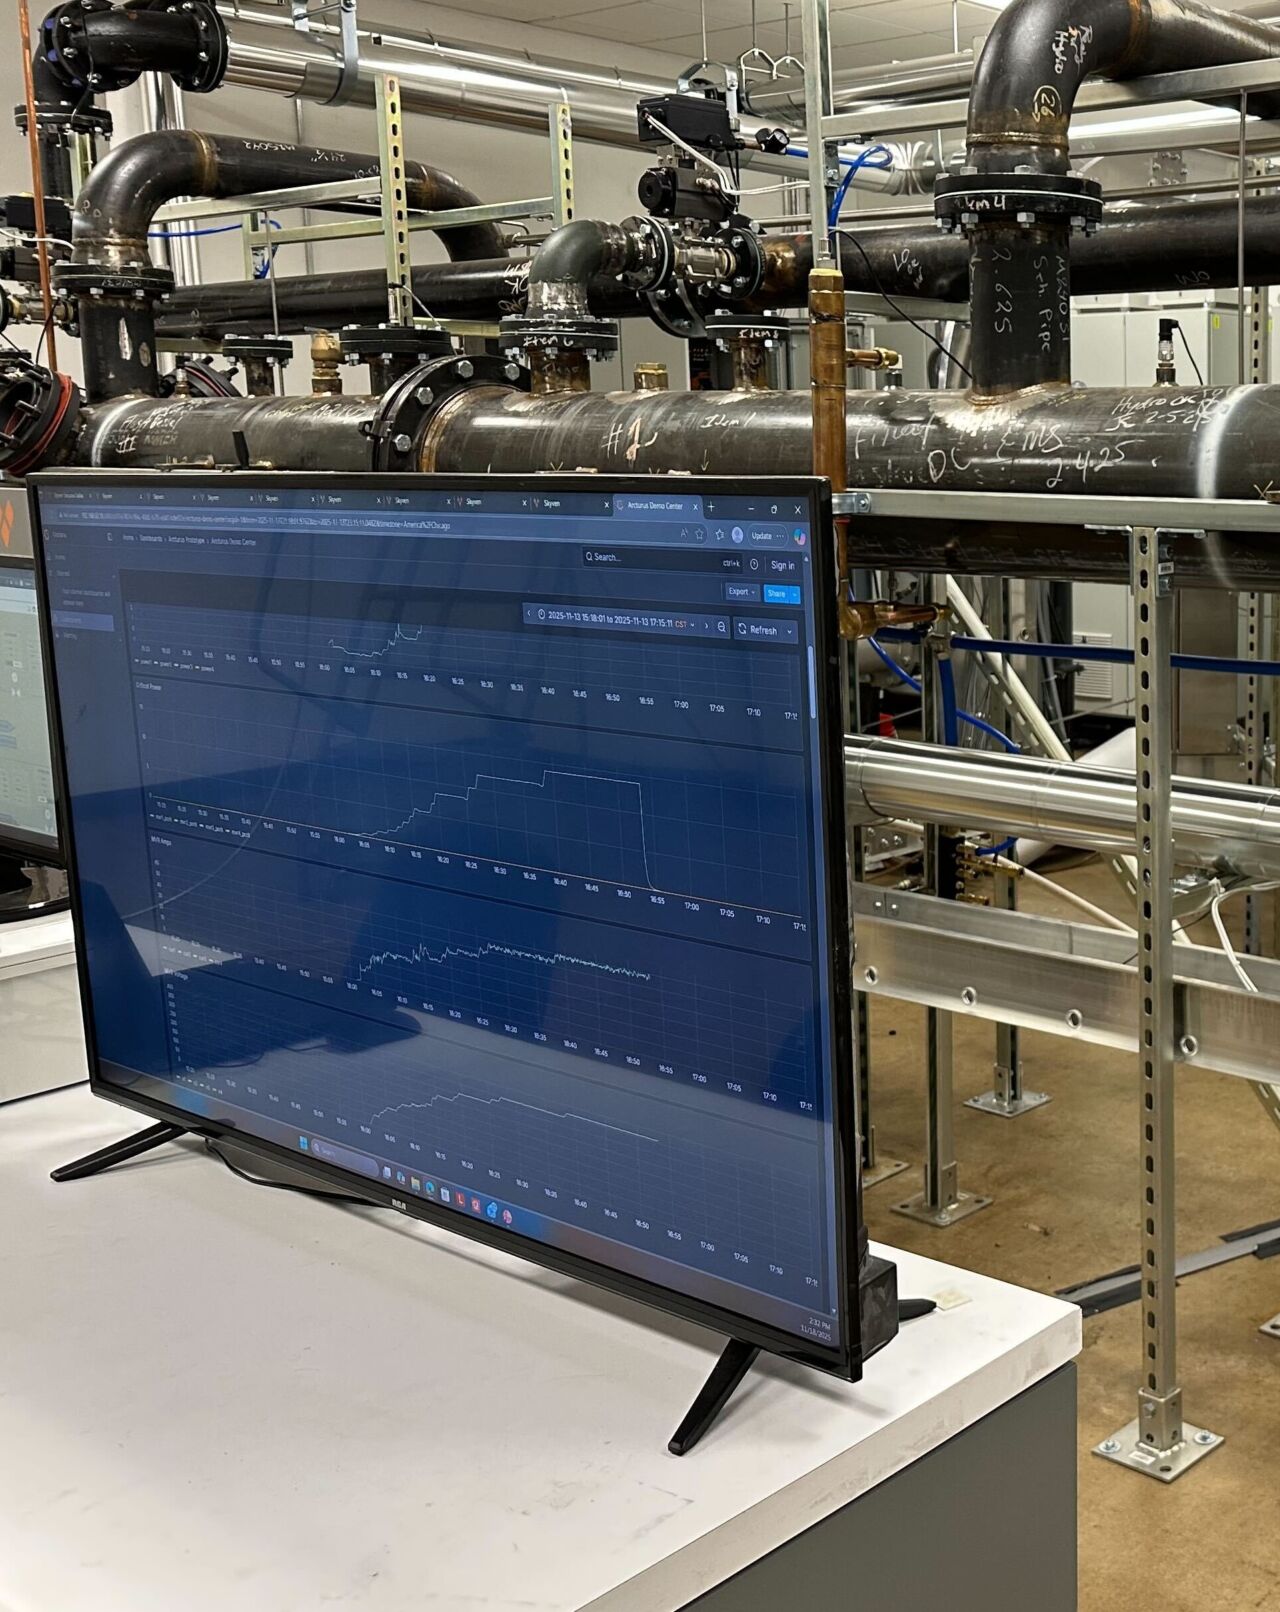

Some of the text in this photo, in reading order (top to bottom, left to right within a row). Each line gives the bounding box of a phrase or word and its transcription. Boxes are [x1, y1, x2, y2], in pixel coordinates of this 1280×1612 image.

[994, 194, 1006, 210] 4
[523, 336, 575, 347] Item 6
[1111, 394, 1167, 416] Hydro
[543, 499, 560, 508] Skyven
[627, 501, 684, 510] Arcturus Demo Center
[752, 532, 772, 541] Update
[771, 561, 795, 571] Sign in
[729, 587, 748, 596] Export
[768, 590, 785, 598] Share
[548, 611, 581, 621] 2025-11-13
[614, 617, 649, 626] 2025-11-13
[650, 618, 673, 627] 17:15:11
[674, 620, 688, 628] CST
[750, 625, 777, 636] Refresh
[674, 700, 688, 708] 17:00
[709, 703, 724, 712] 17:05
[747, 707, 760, 716] 17:10
[684, 901, 699, 911] 17:00
[720, 908, 734, 918] 17:05
[756, 914, 770, 924] 17:10
[692, 1073, 706, 1083] 17:00
[727, 1081, 741, 1092] 17:05
[763, 1091, 776, 1101] 17:10
[700, 1240, 714, 1252] 17:00
[734, 1252, 748, 1263] 17:05
[769, 1264, 782, 1275] 17:10
[809, 1317, 831, 1330] 2:32 PM
